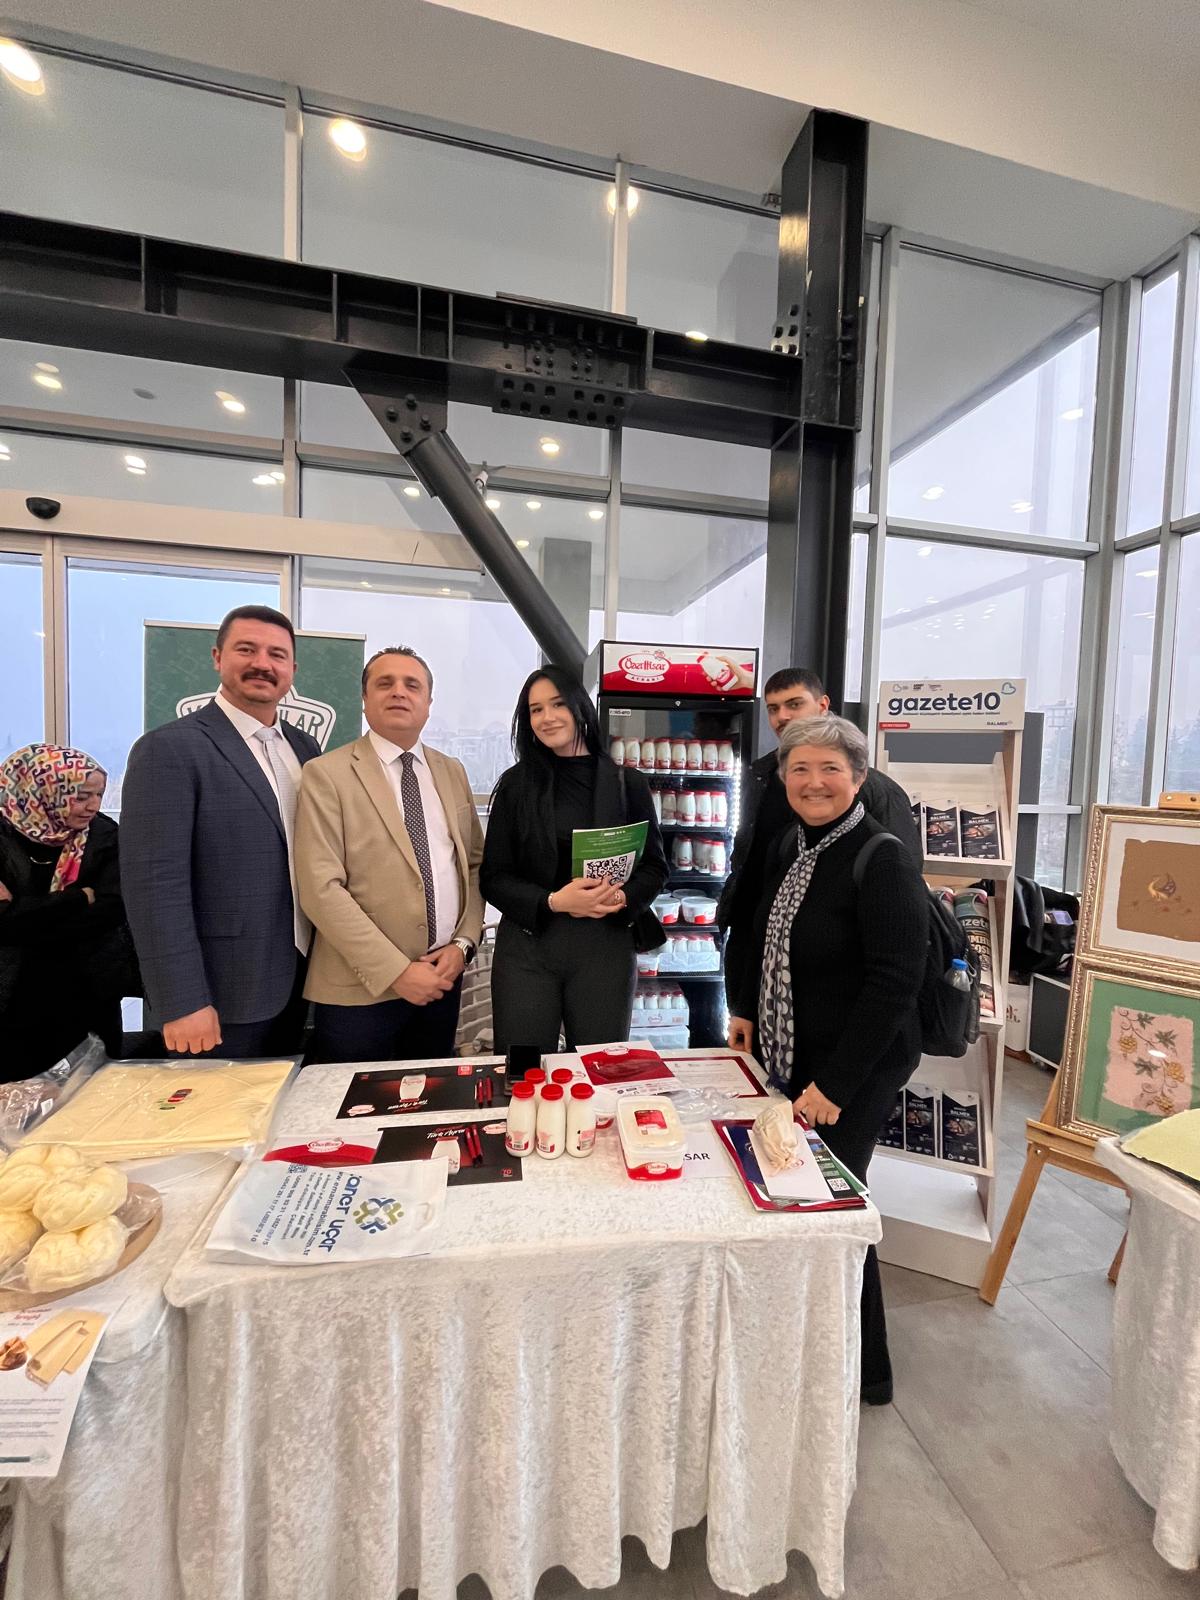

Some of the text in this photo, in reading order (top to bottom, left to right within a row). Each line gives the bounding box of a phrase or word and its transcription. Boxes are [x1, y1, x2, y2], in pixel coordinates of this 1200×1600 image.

[888, 691, 1000, 716] gazete10
[683, 1152, 711, 1161] SAR
[318, 1173, 363, 1252] aner uçar
